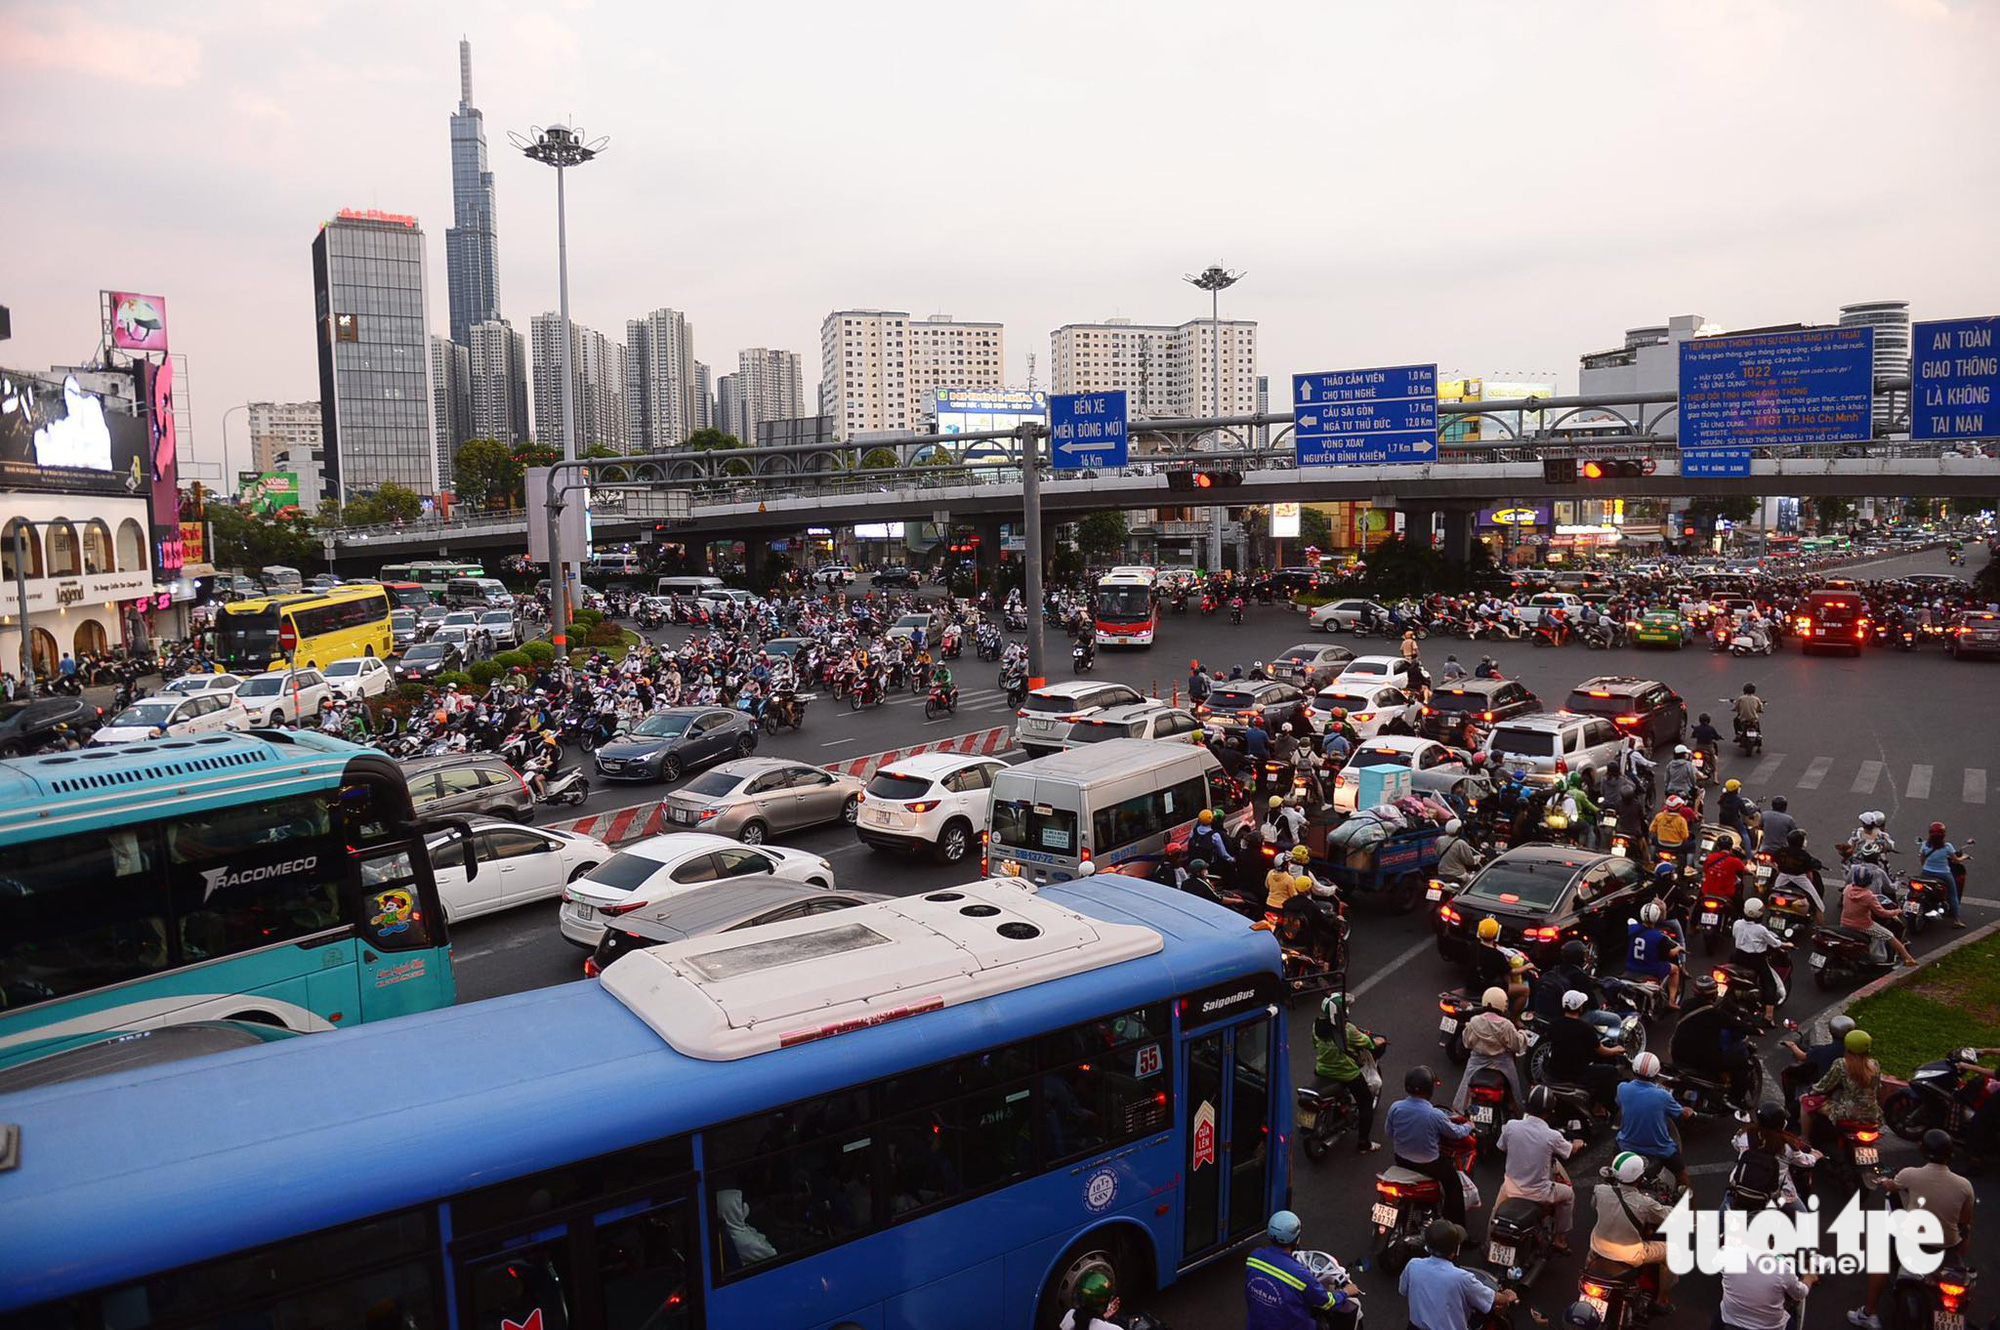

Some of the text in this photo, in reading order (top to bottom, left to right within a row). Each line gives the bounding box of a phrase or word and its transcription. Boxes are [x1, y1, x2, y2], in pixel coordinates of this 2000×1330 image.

[1932, 326, 1991, 350] AN TOÀN
[1366, 372, 1385, 384] VIÊN
[1420, 371, 1432, 380] Km
[1743, 366, 1771, 378] 1022
[1922, 355, 1998, 379] GIAO THÔNG
[1322, 391, 1339, 401] CHỢ
[1340, 390, 1353, 400] THỊ
[1355, 386, 1376, 398] NGHÈ
[1420, 385, 1432, 394] Km
[1926, 383, 1990, 406] LÀ KHÔNG
[1074, 394, 1106, 415] BẾN XE
[1322, 405, 1339, 418] CẦU
[1341, 405, 1355, 417] SÀI
[1356, 404, 1374, 416] GÒN
[1421, 403, 1433, 413] Km
[1053, 416, 1123, 439] MIỀN ĐÔNG MỚI
[1323, 421, 1340, 432] NGÃ
[1342, 420, 1354, 431] TƯ
[1356, 419, 1372, 430] THỦ
[1373, 417, 1391, 429] ĐỨC
[1420, 417, 1433, 427] Km
[1931, 414, 1983, 435] TAI NẠN
[1321, 438, 1343, 449] VÒNG
[1345, 438, 1365, 448] XOAY
[1399, 443, 1411, 453] Km
[1080, 453, 1103, 466] 16 Km
[1303, 451, 1335, 464] NGUYỄN
[1359, 450, 1386, 461] KHIÊM
[56, 585, 85, 606] Legend
[199, 856, 318, 904] TRACOMECO
[1634, 937, 1646, 960] 2
[1202, 989, 1255, 1012] SaigonBus
[1140, 1046, 1158, 1074] 55
